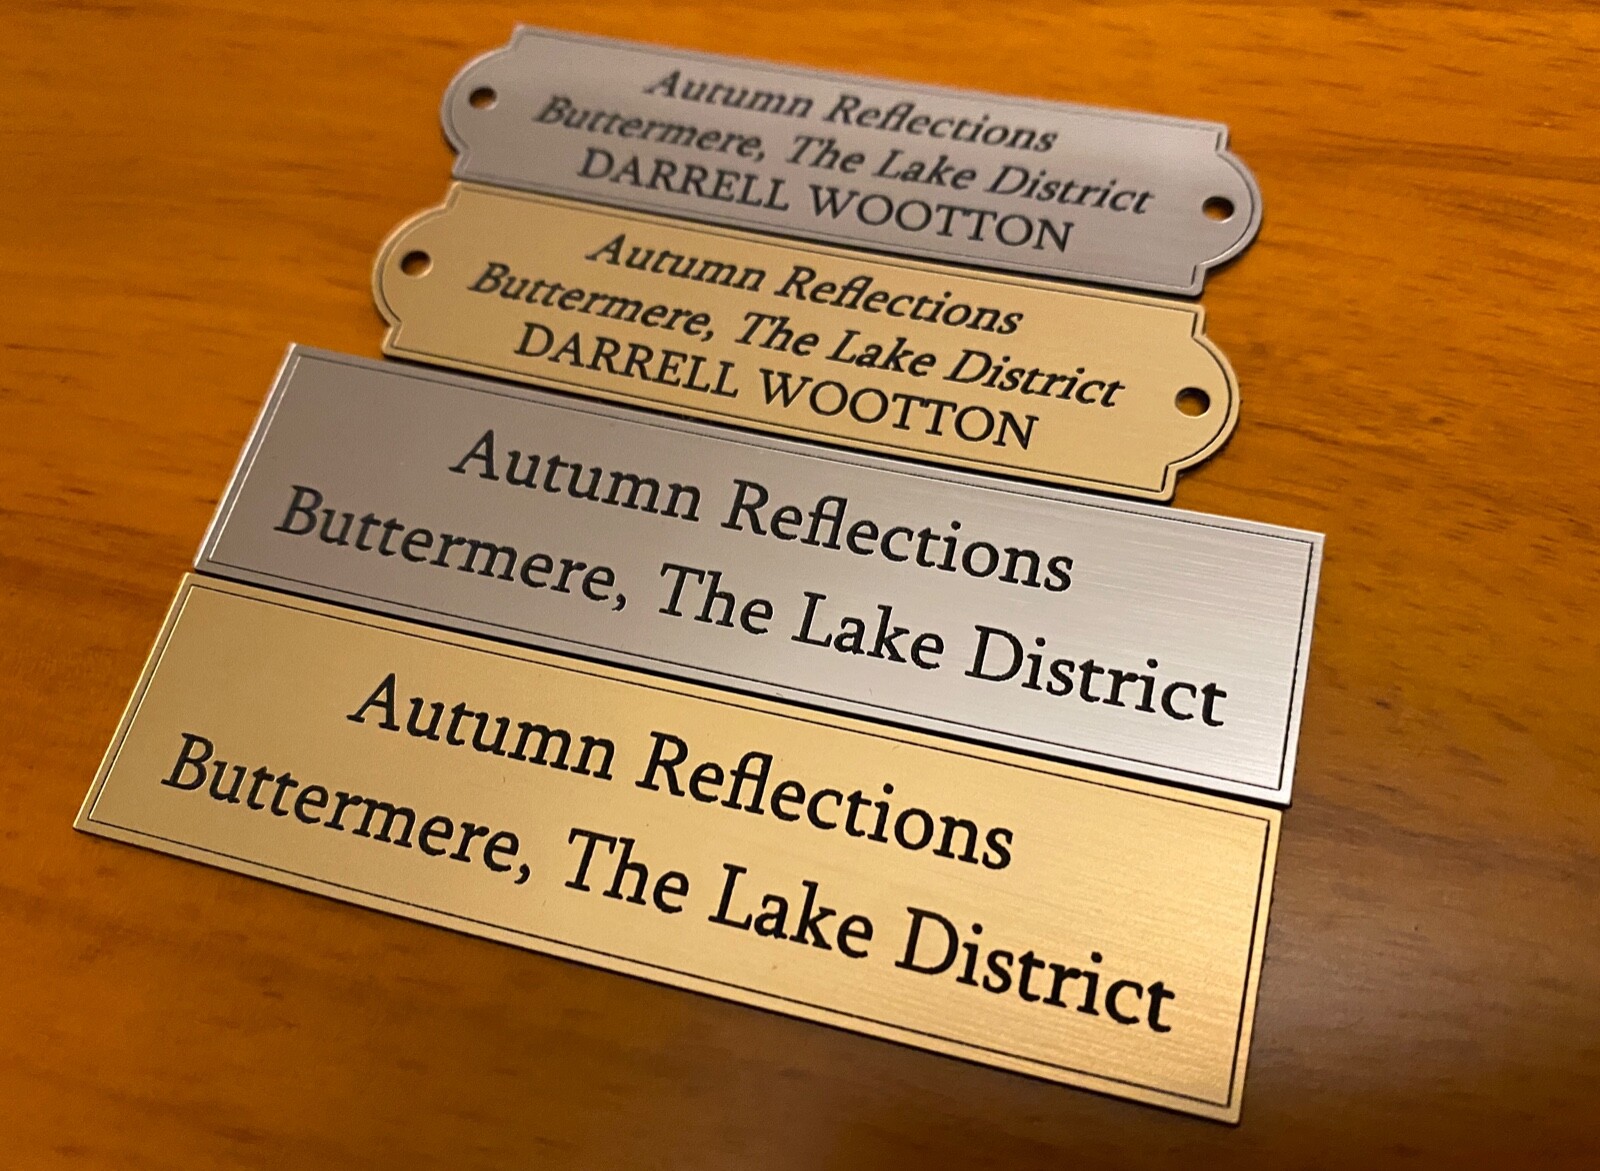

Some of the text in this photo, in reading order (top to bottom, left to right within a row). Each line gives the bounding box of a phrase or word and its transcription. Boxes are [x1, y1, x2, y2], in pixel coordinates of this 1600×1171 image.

[535, 95, 1154, 215] Buttermere, The Lake District
[645, 70, 1057, 153] Autumn Reflections
[577, 147, 1075, 253] DARRELL WOOTTON
[467, 262, 1125, 408] Buttermere, The Lake District
[585, 234, 1024, 336] Autumn Reflections
[514, 321, 1040, 451] DARRELL WOOTTON
[448, 429, 1074, 592] Autumn Reflections
[273, 484, 1228, 728] Buttermere, The Lake District
[346, 672, 1014, 870] Autumn Reflections
[160, 732, 1176, 1034] Buttermere, The Lake District
